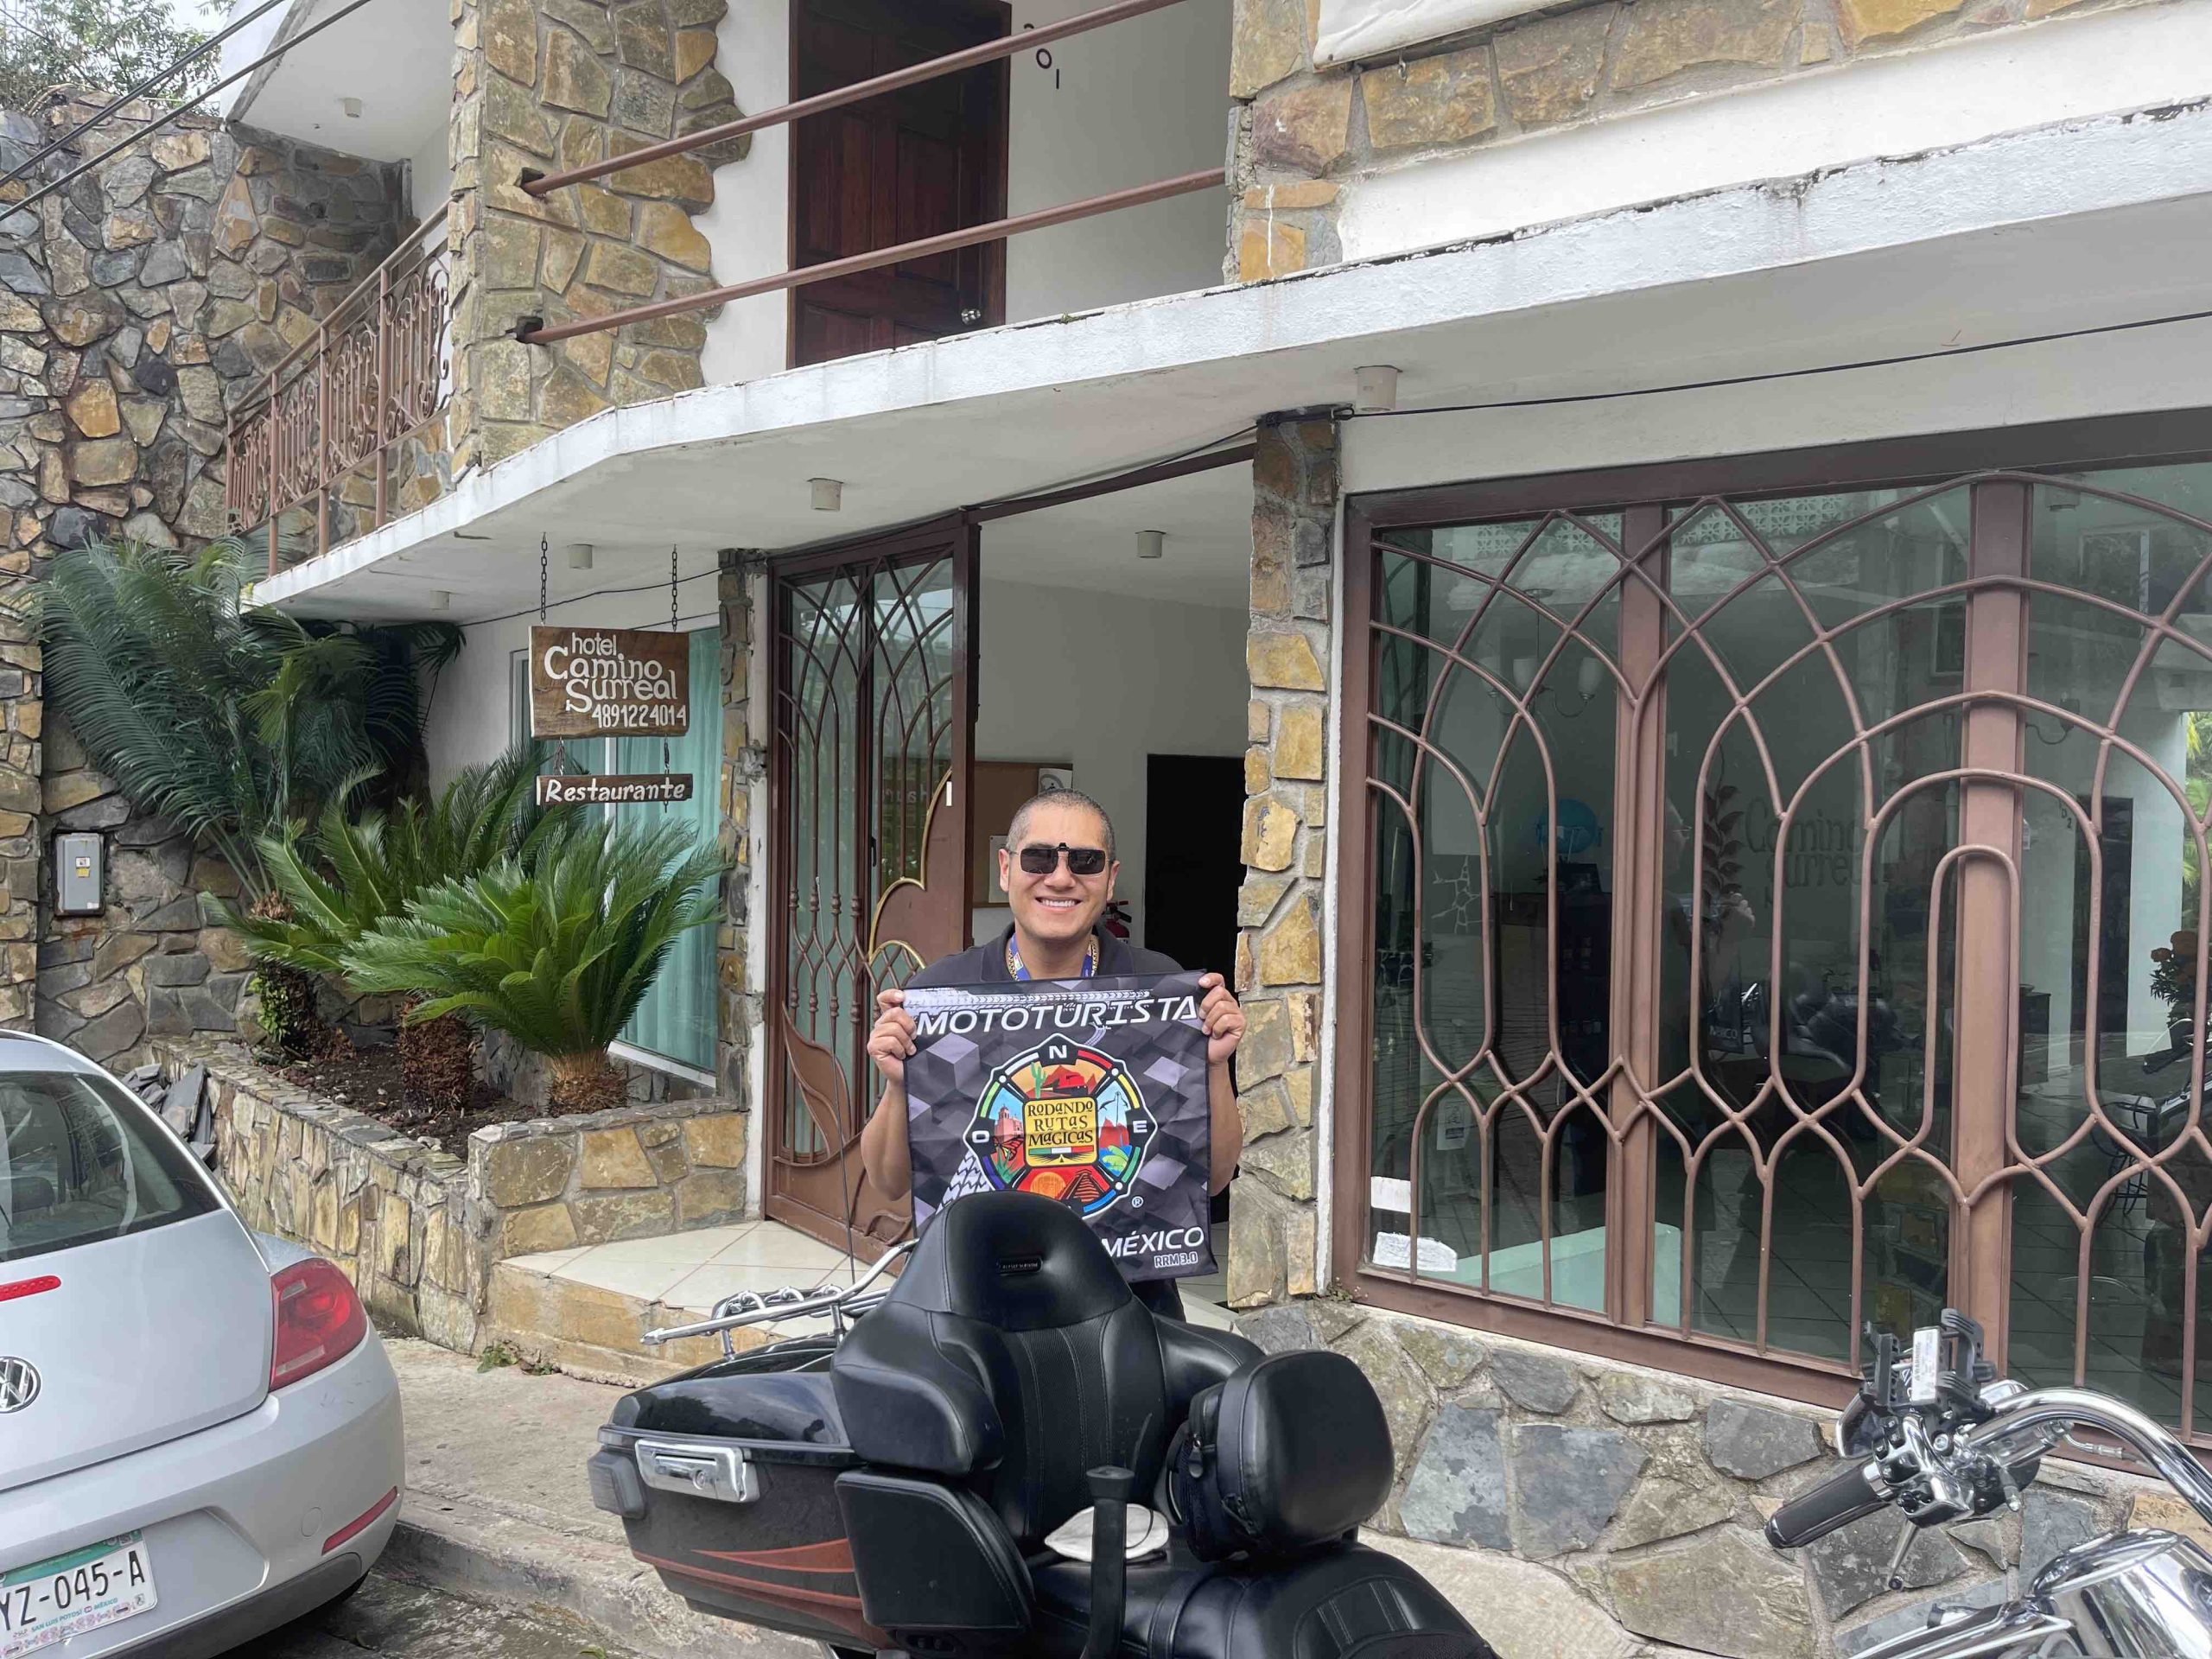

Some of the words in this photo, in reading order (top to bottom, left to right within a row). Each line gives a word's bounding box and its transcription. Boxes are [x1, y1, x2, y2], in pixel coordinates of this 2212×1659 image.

[571, 632, 618, 657] hotel
[543, 645, 663, 680] Camino
[565, 669, 678, 713] Surreal
[591, 704, 687, 728] 4891224014
[545, 777, 685, 803] Restaurante
[916, 995, 1198, 1036] MOTOTURISTA
[1048, 1045, 1068, 1059] N
[1132, 1120, 1147, 1133] E
[1101, 1226, 1205, 1258] MÉXICO
